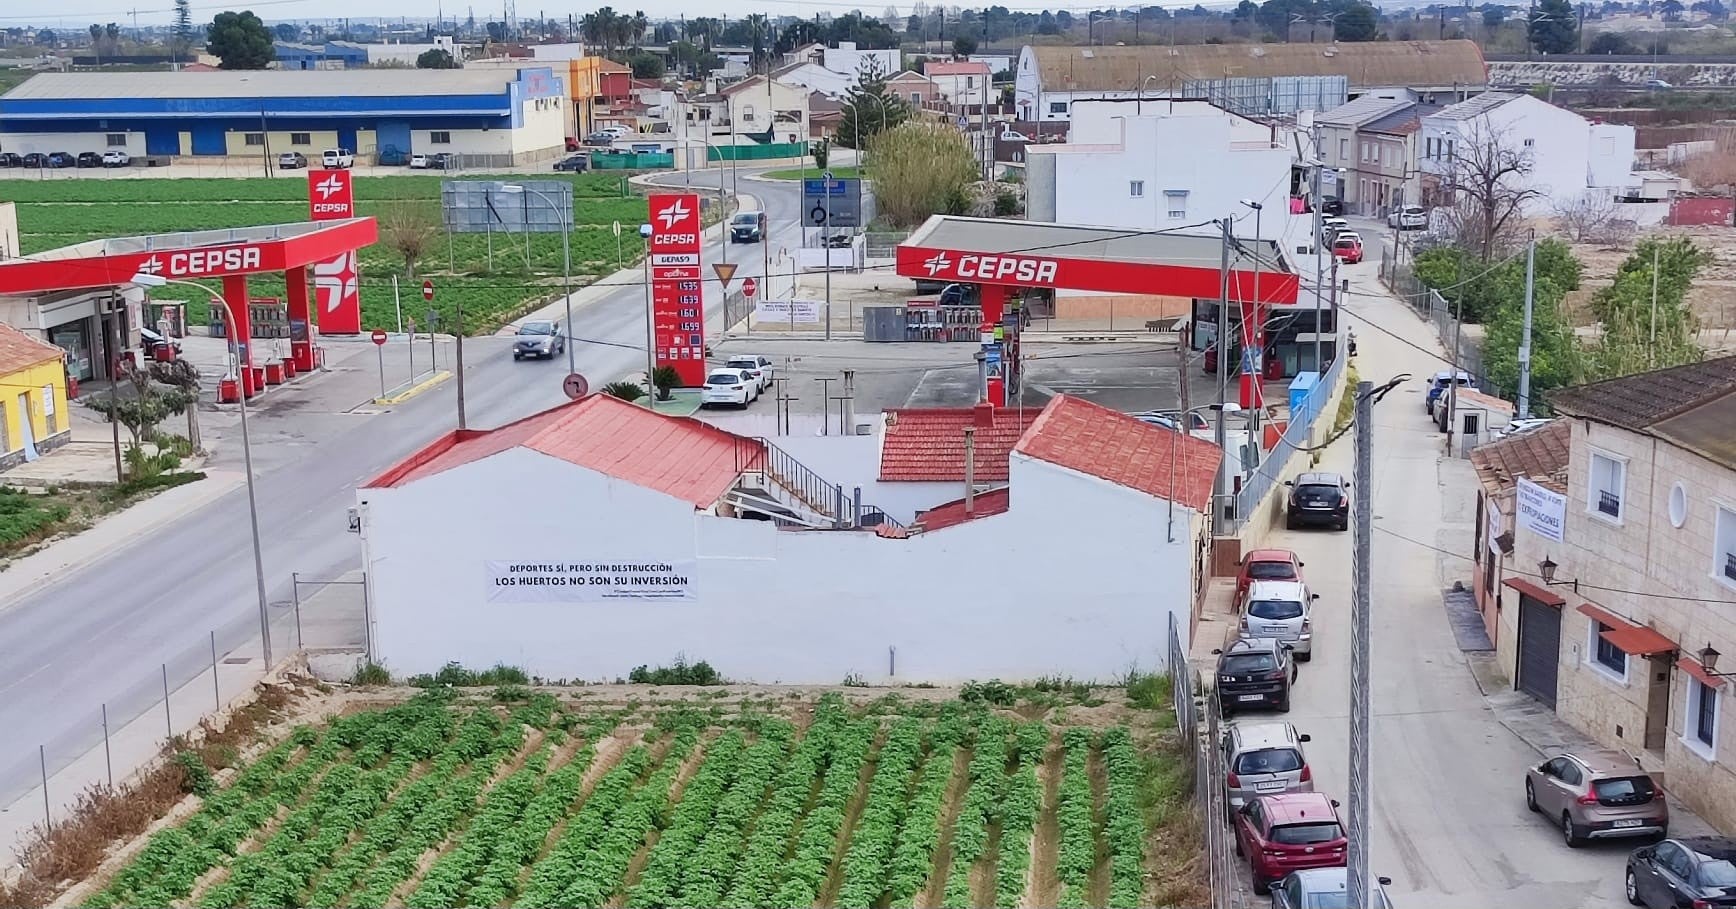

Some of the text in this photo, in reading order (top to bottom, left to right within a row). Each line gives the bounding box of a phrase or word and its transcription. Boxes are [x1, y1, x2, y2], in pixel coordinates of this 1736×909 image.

[313, 203, 349, 213] CEPSA
[654, 234, 696, 245] CEPSA
[170, 247, 261, 276] CEPSA
[957, 255, 1058, 283] CEPSA
[510, 564, 554, 573] DEPORTES
[569, 564, 593, 573] PERO
[595, 564, 609, 572] SIN
[611, 563, 673, 572] DESTRUCCIÓN
[495, 574, 688, 586] LOS HUERTOS NO SON SU INVERSIÓN
